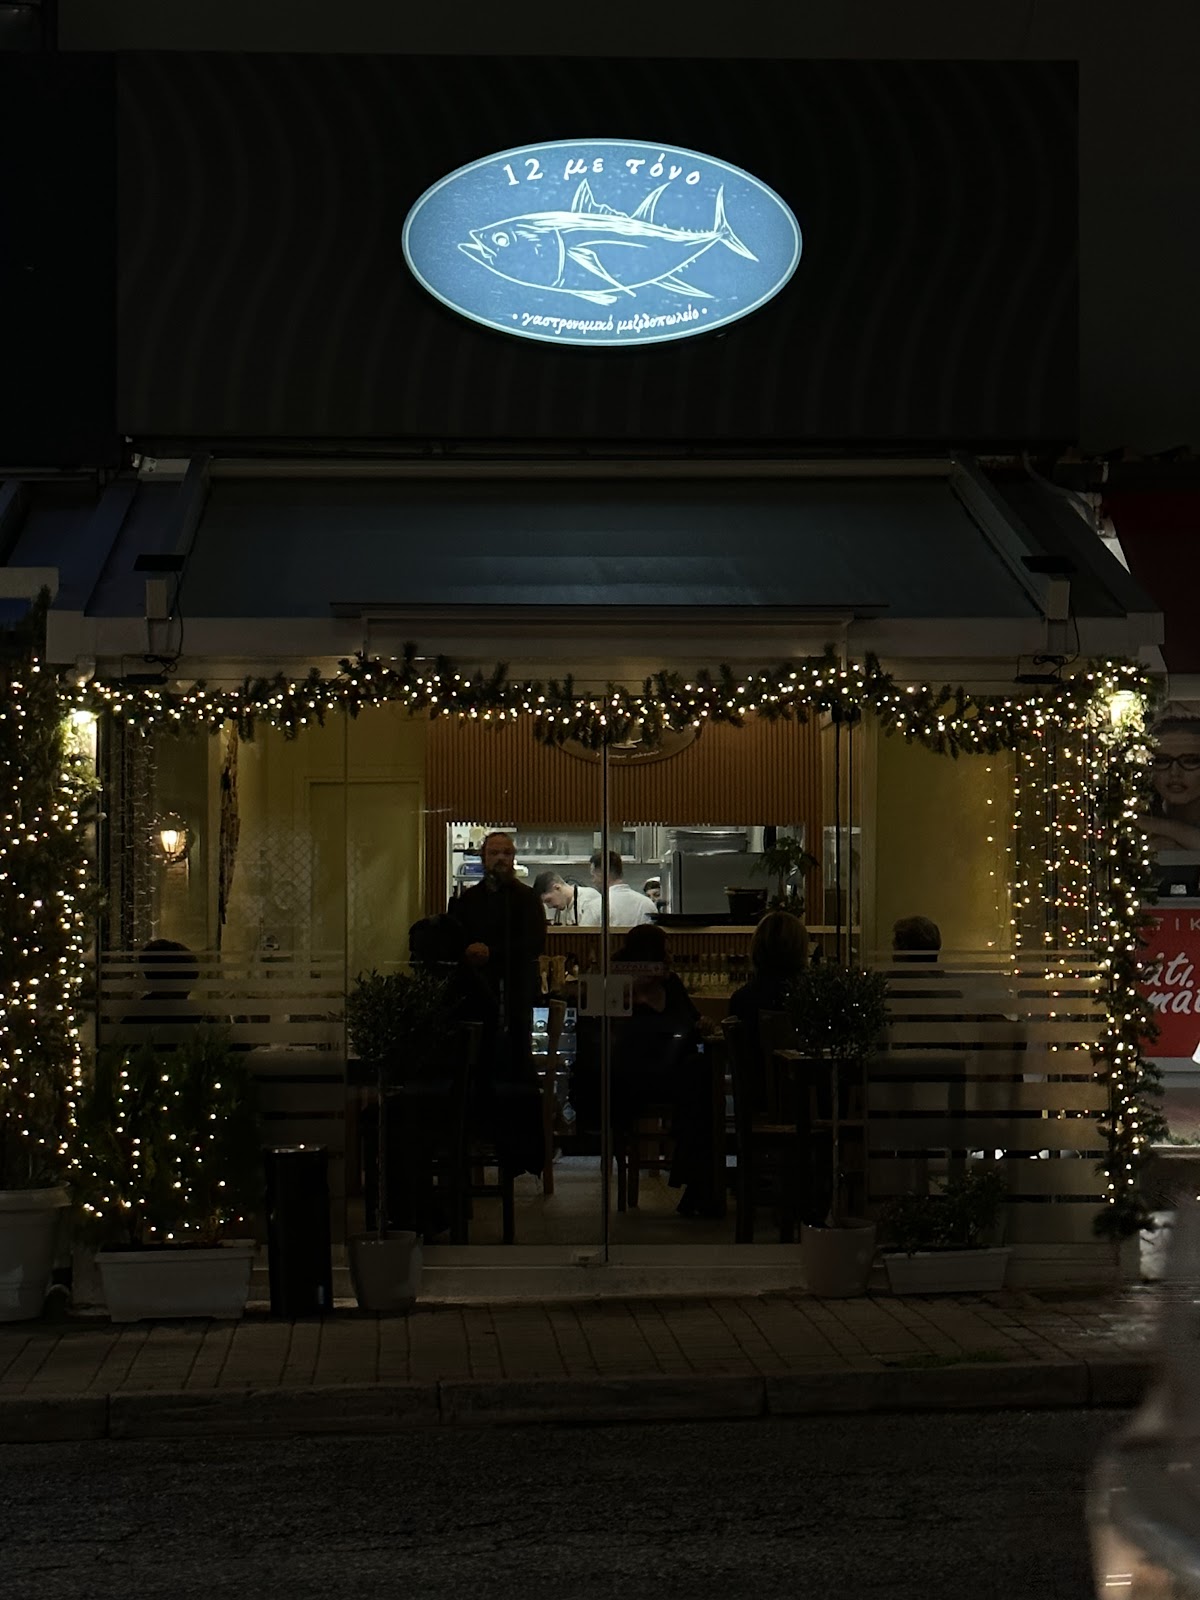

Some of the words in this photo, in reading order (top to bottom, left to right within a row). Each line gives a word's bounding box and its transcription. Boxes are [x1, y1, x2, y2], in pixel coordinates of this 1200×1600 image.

[503, 158, 543, 186] 12
[563, 157, 604, 181] με
[625, 152, 700, 185] τόνο
[522, 312, 614, 334] γαστρονομικό
